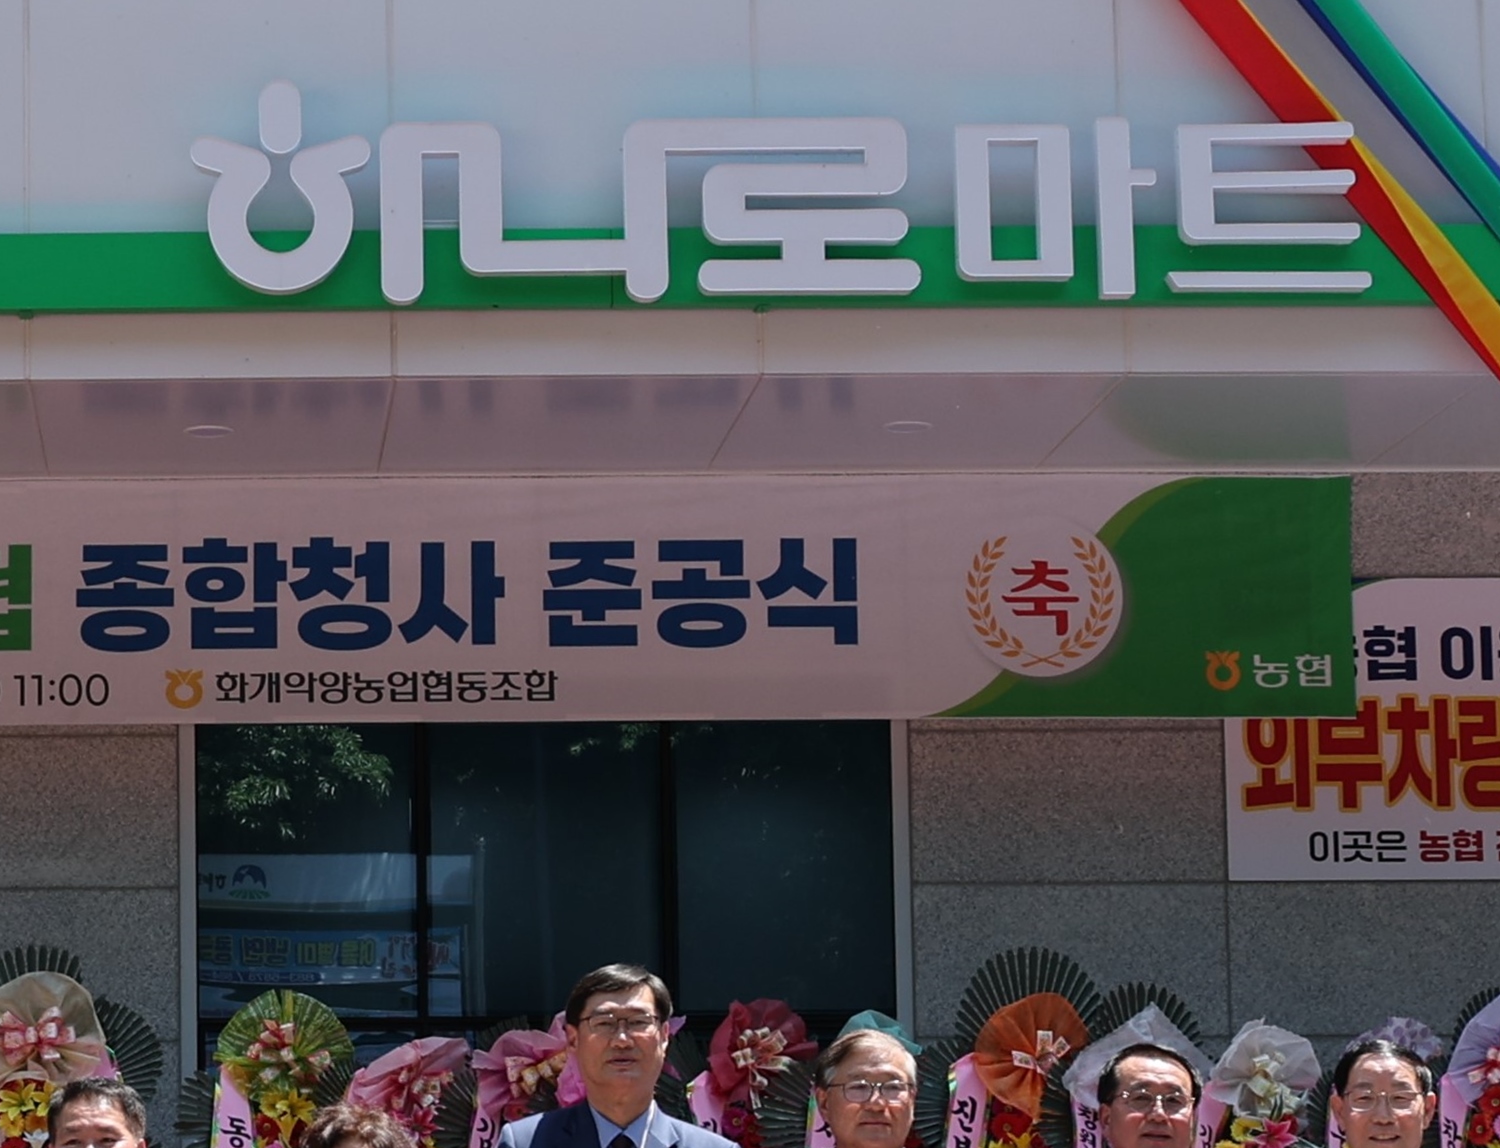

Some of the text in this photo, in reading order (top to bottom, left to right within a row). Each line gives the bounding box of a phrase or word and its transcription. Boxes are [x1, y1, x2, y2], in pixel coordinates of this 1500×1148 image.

[74, 541, 506, 655] 종합청사
[543, 538, 860, 650] 준공식
[1000, 558, 1080, 636] 축
[1353, 624, 1418, 682] 협
[13, 673, 110, 706] 11:00
[215, 669, 559, 705] 화개악양농업협동조합
[1252, 654, 1333, 689] 농협
[1308, 830, 1408, 864] 이곳은
[1418, 830, 1484, 863] 농협
